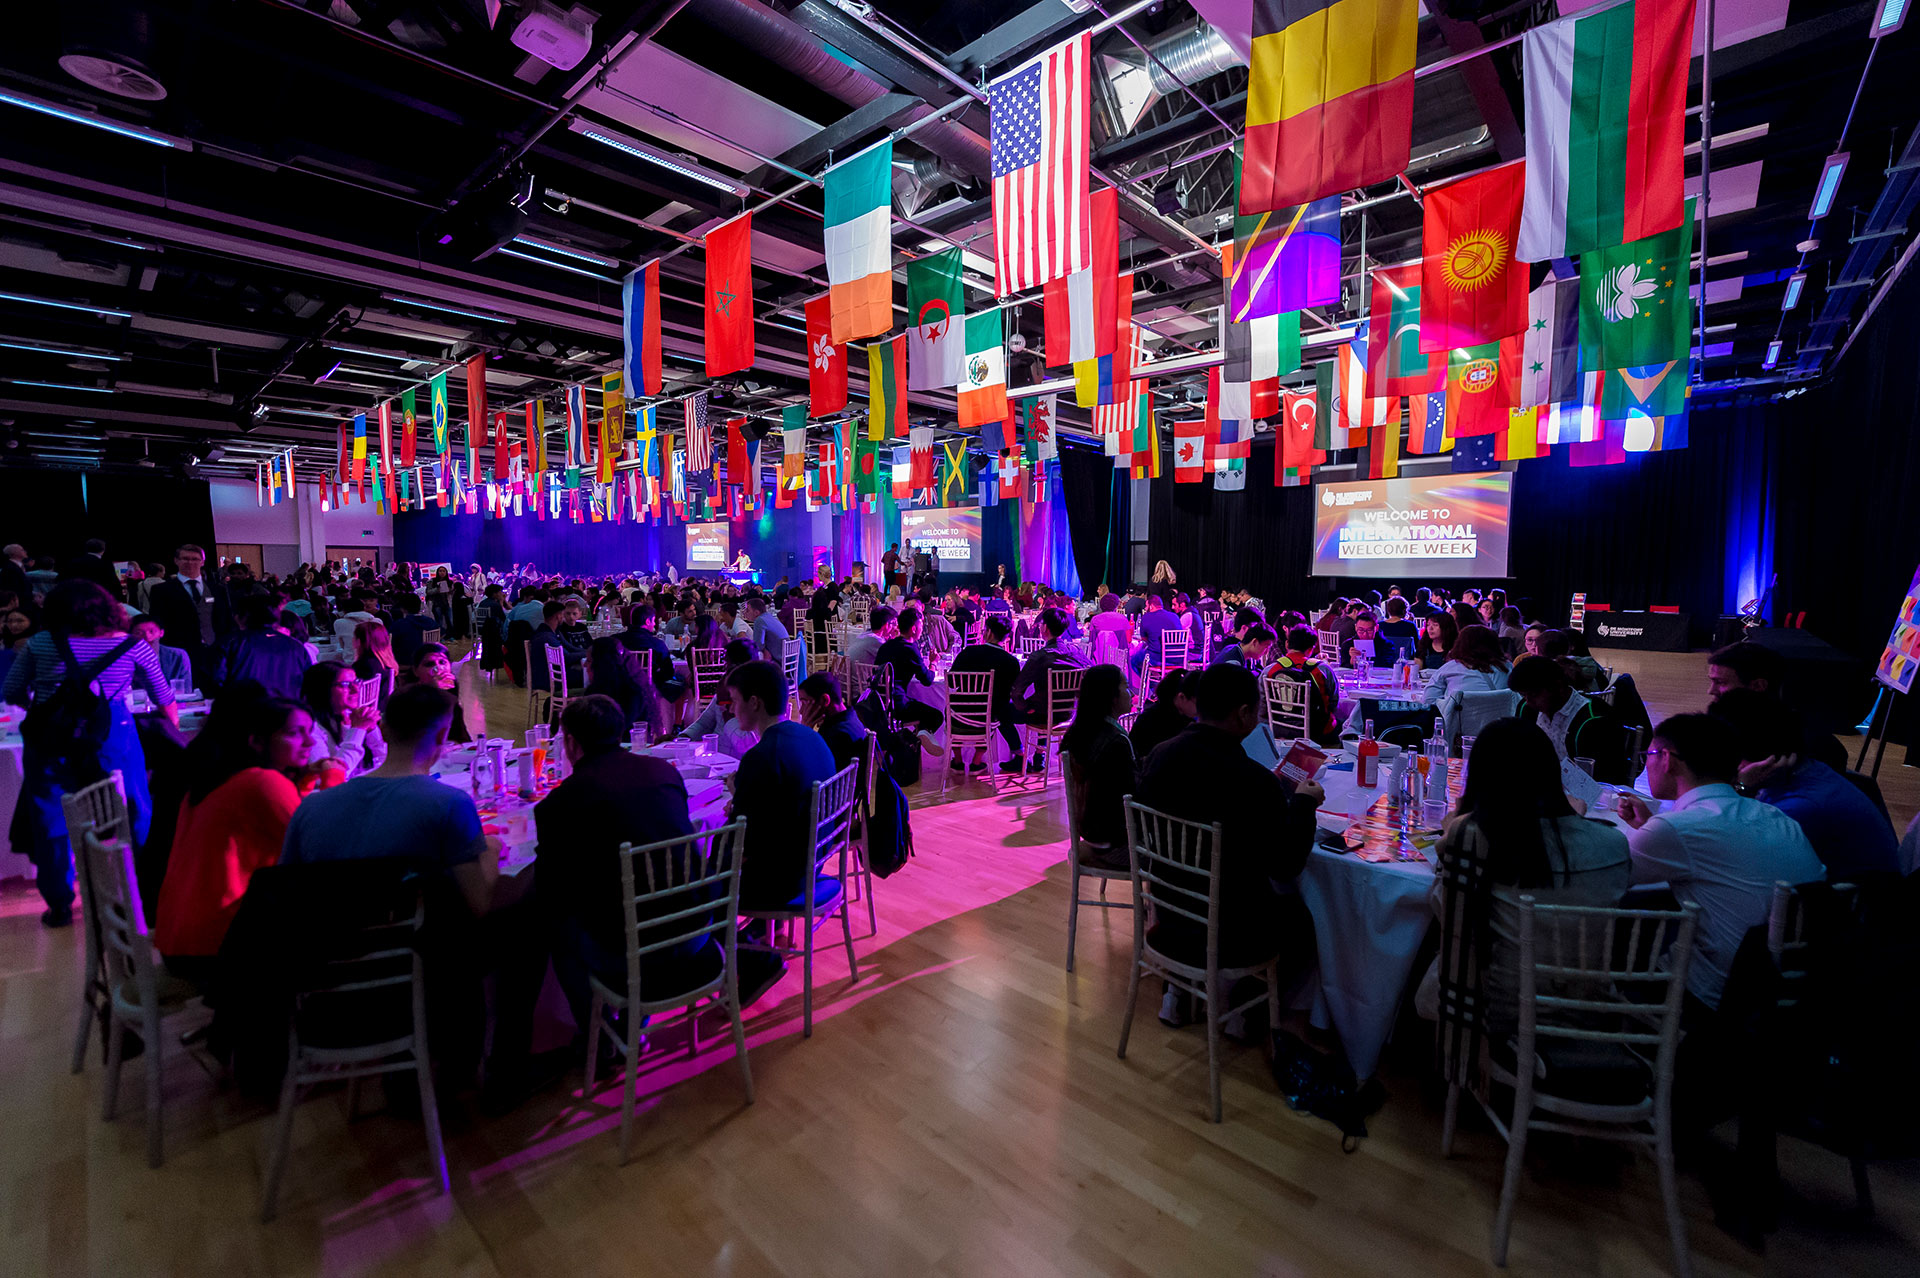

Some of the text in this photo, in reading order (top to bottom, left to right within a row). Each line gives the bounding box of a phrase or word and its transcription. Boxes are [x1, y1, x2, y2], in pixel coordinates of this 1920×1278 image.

[1364, 508, 1450, 521] WELCOME TO
[1340, 525, 1476, 540] INTERNATIONAL
[911, 538, 970, 548] INTERNATIONAL
[1342, 542, 1473, 555] WELCOME WEEK
[948, 549, 969, 557] WEEK
